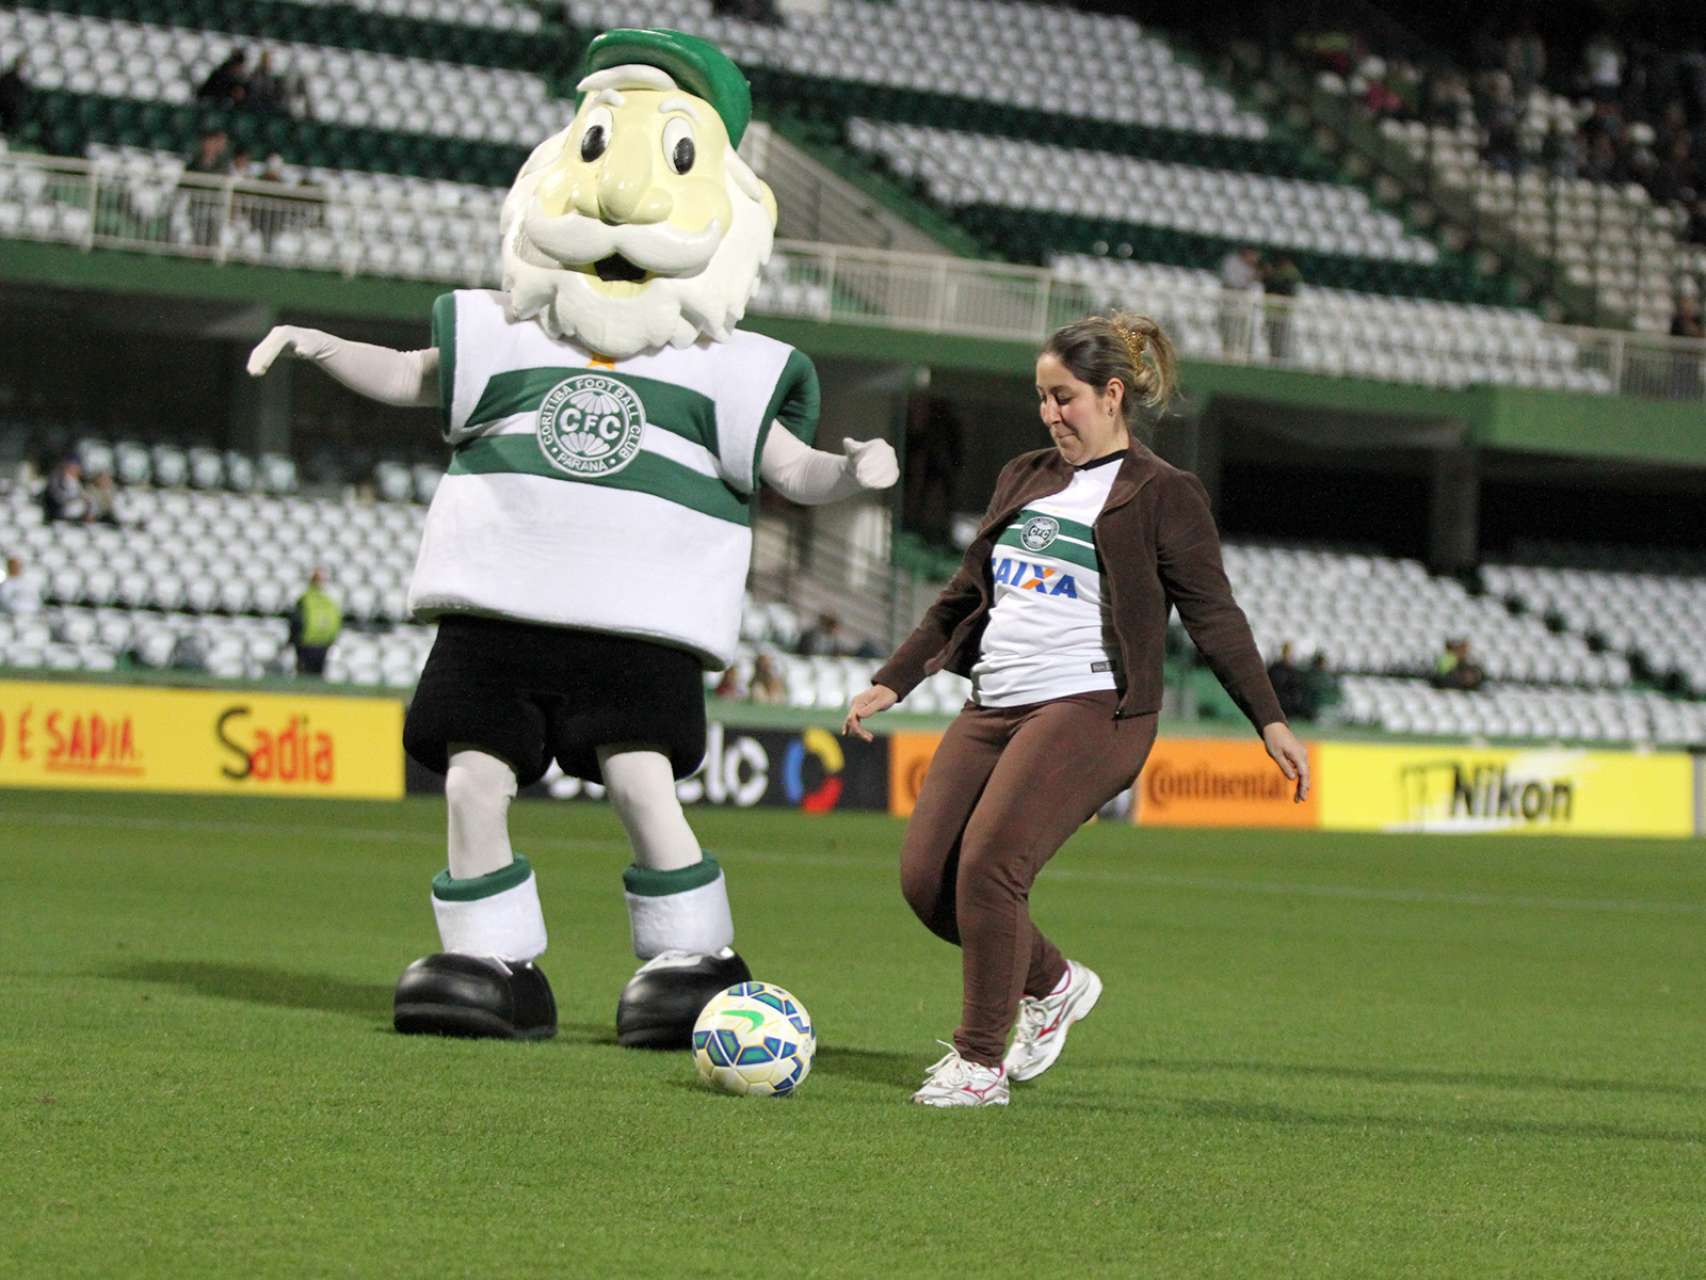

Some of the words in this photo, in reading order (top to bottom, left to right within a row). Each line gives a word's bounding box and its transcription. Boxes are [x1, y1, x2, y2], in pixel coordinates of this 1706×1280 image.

[542, 384, 573, 445] CORITIBA
[619, 425, 641, 459] CLUB
[560, 408, 621, 440] CFC
[992, 557, 1078, 599] AIXA
[215, 706, 335, 784] Sadia
[1450, 762, 1573, 821] Nikon
